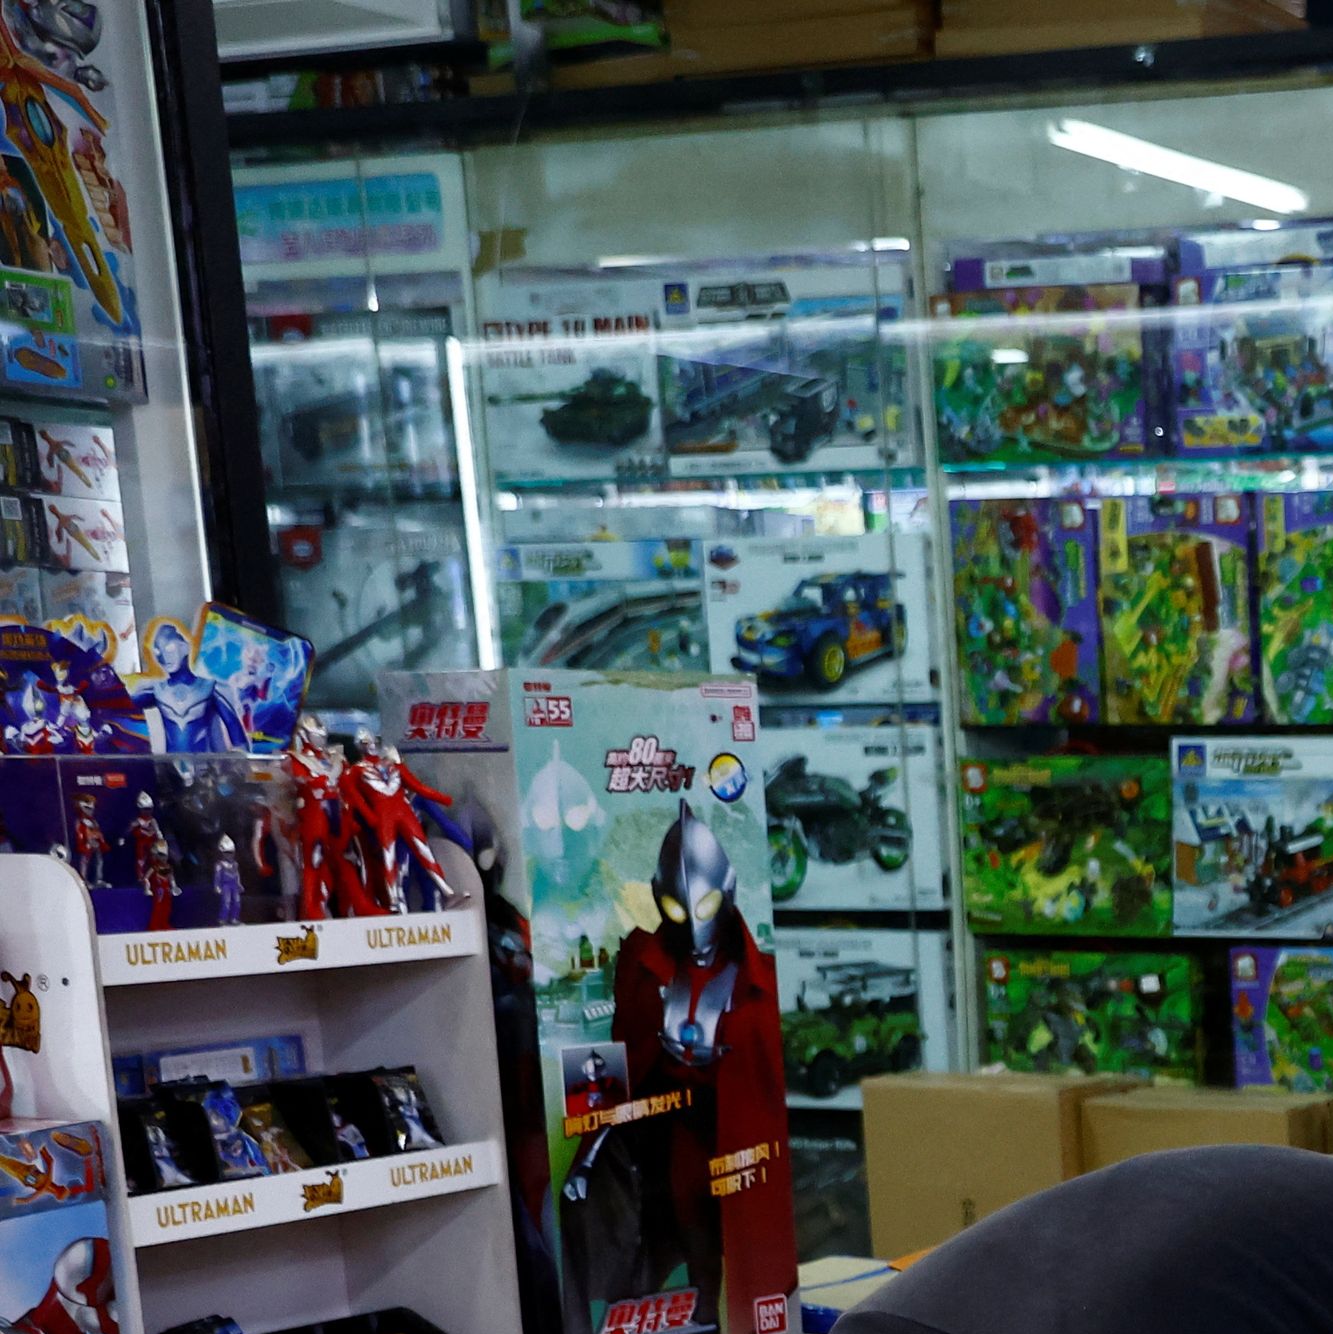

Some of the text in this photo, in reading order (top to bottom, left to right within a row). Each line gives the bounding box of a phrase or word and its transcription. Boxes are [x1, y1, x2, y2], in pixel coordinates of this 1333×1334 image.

[407, 701, 492, 740] 奥特曼
[125, 922, 452, 967] ULTRAMAN ULTRAMAN
[156, 1155, 474, 1229] ULTRAMAN ULTRAMAN
[759, 1303, 785, 1319] BAN
[760, 1315, 781, 1331] DAI
